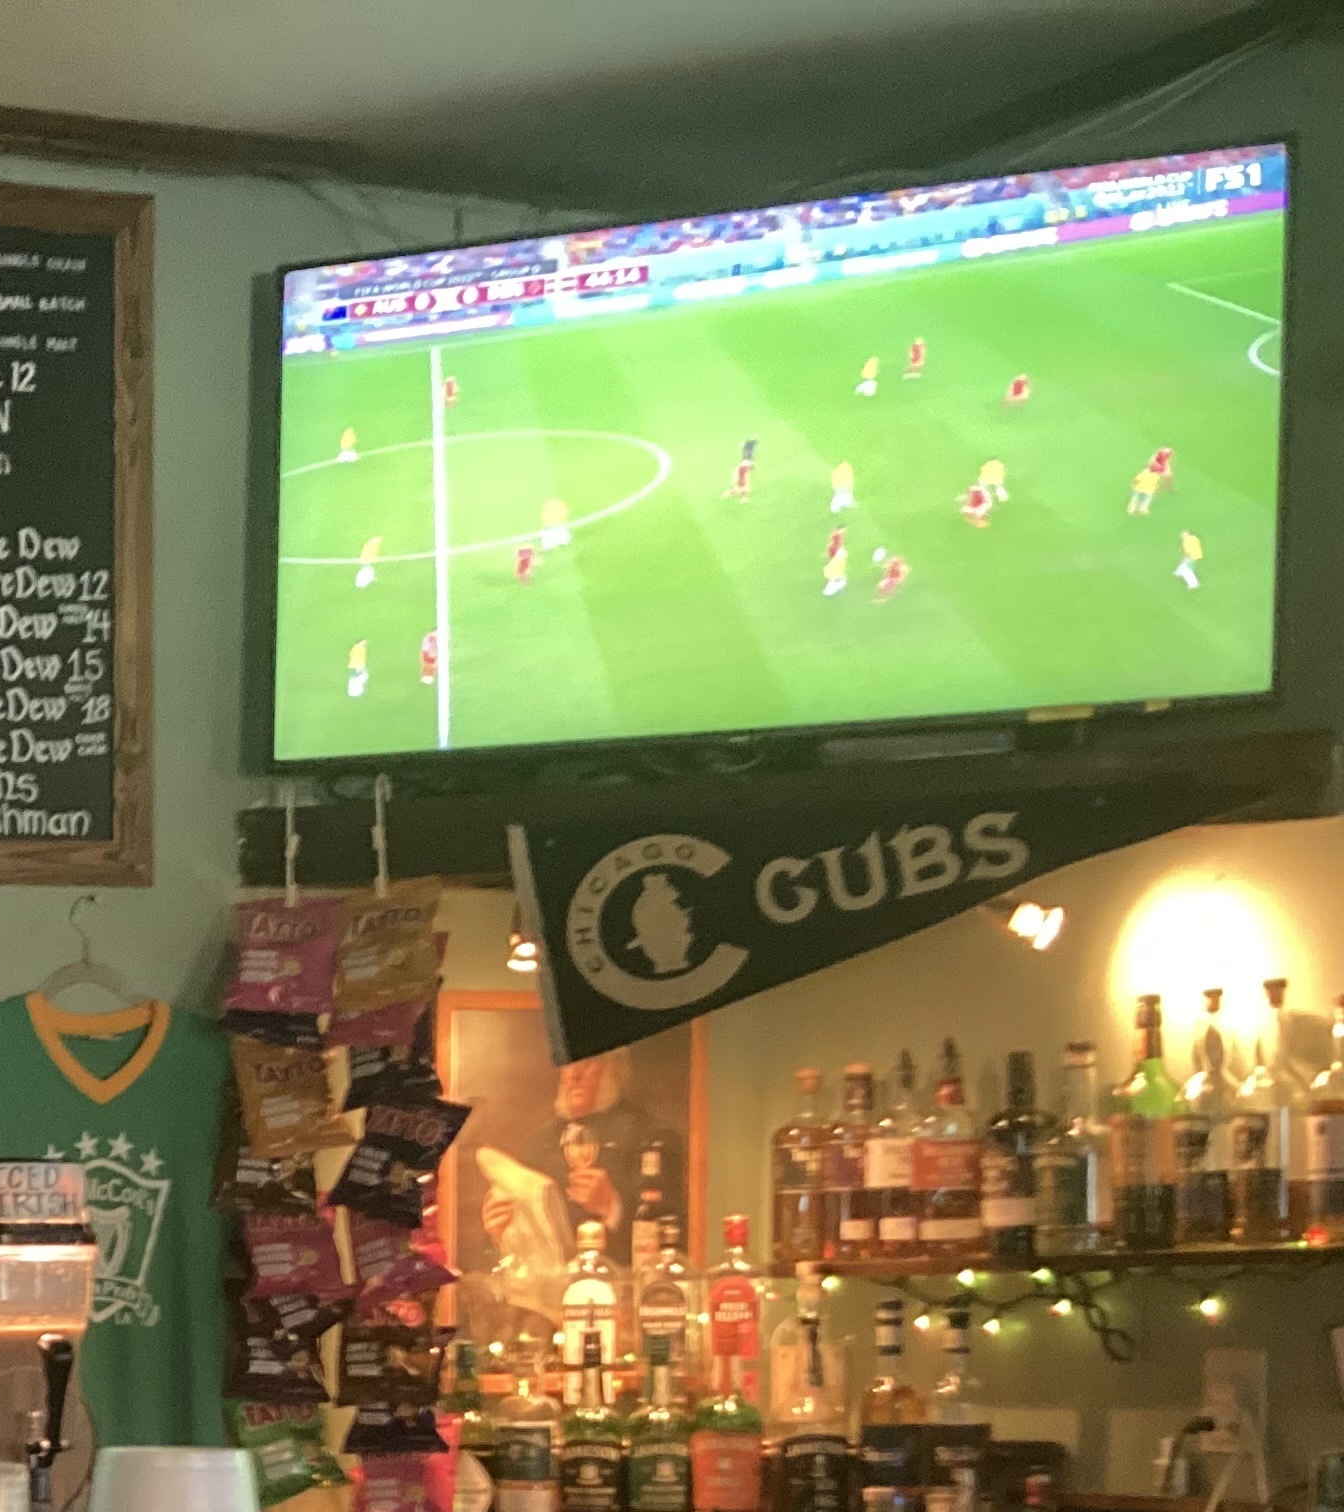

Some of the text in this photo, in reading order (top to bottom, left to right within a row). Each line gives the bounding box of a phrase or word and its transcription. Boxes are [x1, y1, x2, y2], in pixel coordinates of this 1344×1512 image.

[1204, 162, 1262, 192] FS1
[11, 360, 37, 393] 12
[18, 526, 81, 560] Dew
[14, 565, 78, 600] Dew
[78, 569, 110, 602] 12
[82, 607, 111, 643] 14
[0, 645, 61, 682] Dew
[67, 648, 106, 682] 15
[6, 686, 67, 722] Dew
[80, 694, 112, 724] 18
[9, 727, 74, 764] Dew
[755, 811, 1031, 924] CUBS
[577, 842, 696, 976] CHICAGO
